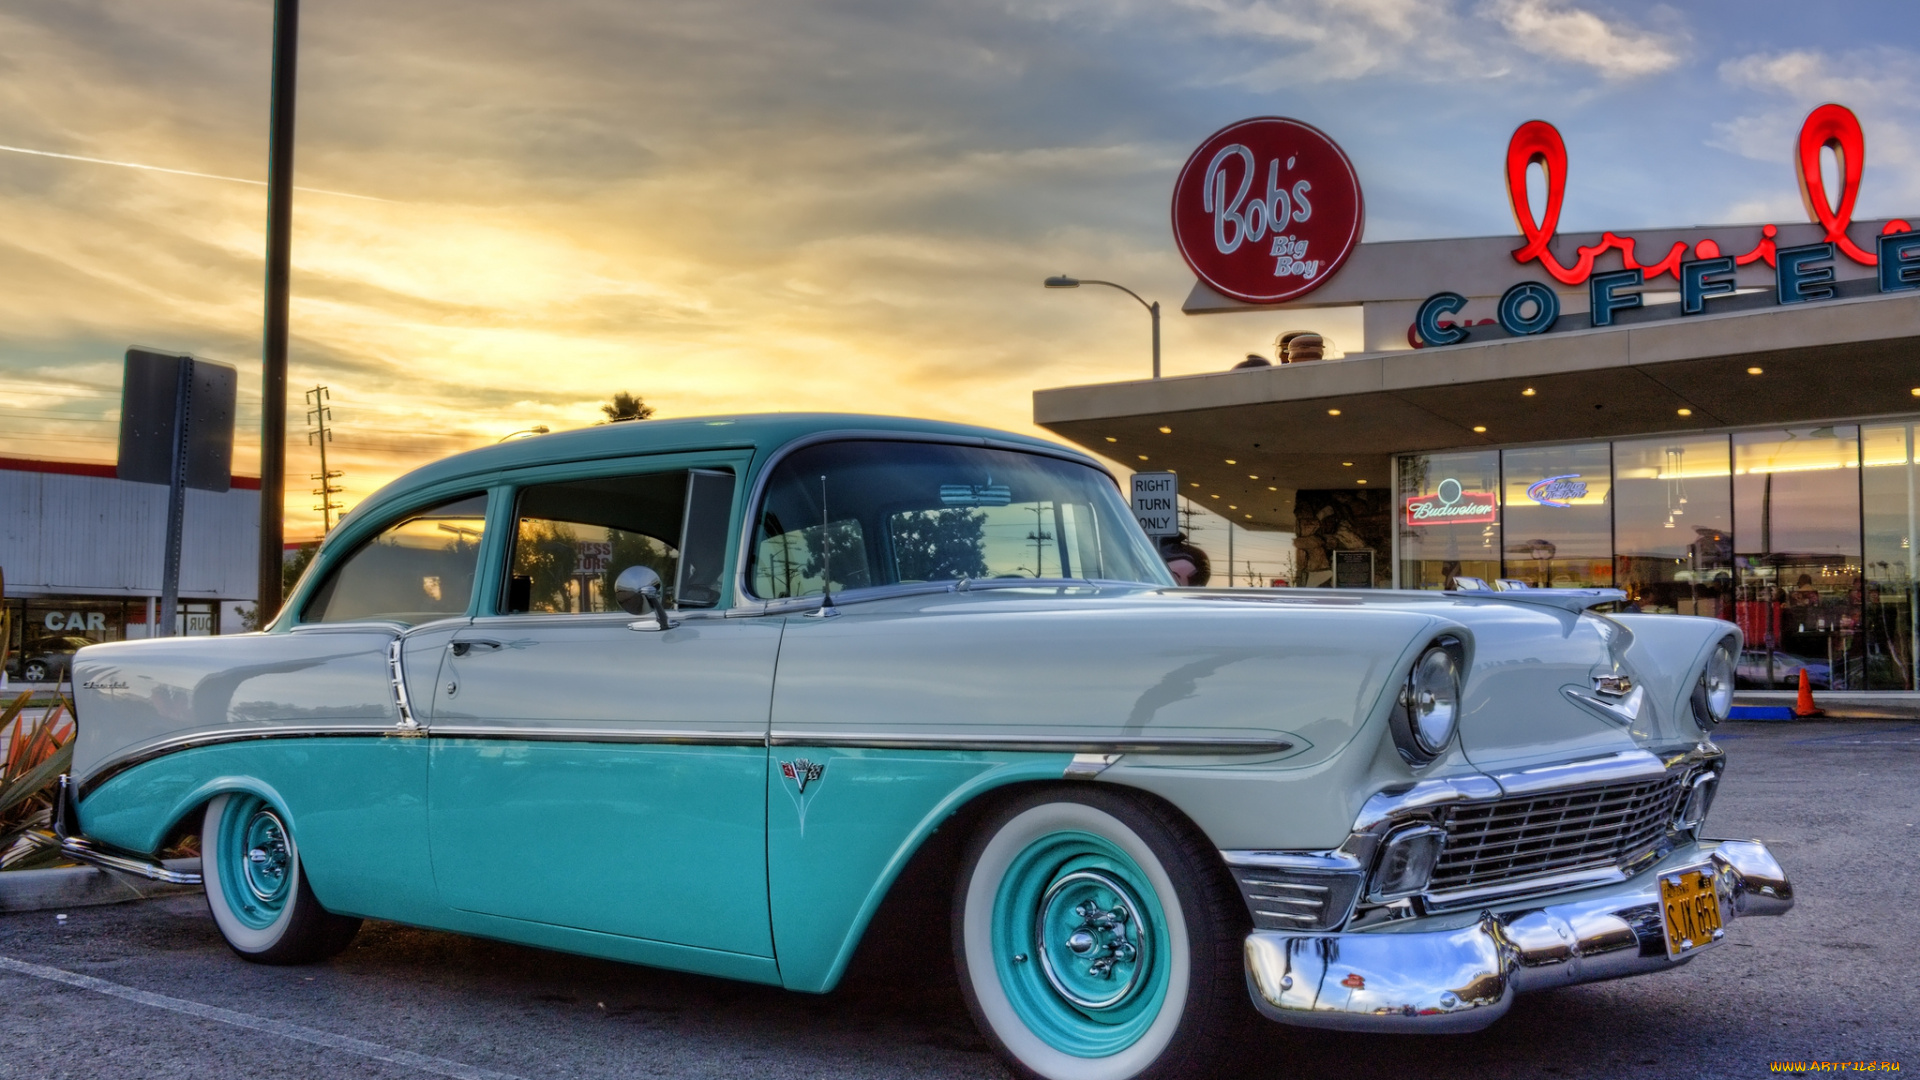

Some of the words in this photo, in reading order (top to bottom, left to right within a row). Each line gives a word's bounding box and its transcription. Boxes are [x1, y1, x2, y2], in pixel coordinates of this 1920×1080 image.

[1203, 143, 1312, 254] Bob's
[1269, 235, 1309, 259] Big
[1273, 256, 1319, 279] Boy
[1415, 229, 1920, 347] COFFEE
[1135, 480, 1171, 492] RIGHT
[1535, 490, 1589, 499] LIGHT
[1545, 482, 1587, 491] BUD
[1138, 498, 1171, 510] TURN
[1409, 502, 1493, 519] Budweiser
[1139, 517, 1171, 529] ONLY
[45, 611, 106, 631] CAR
[1667, 897, 1698, 945] SJX
[1695, 892, 1719, 935] 853
